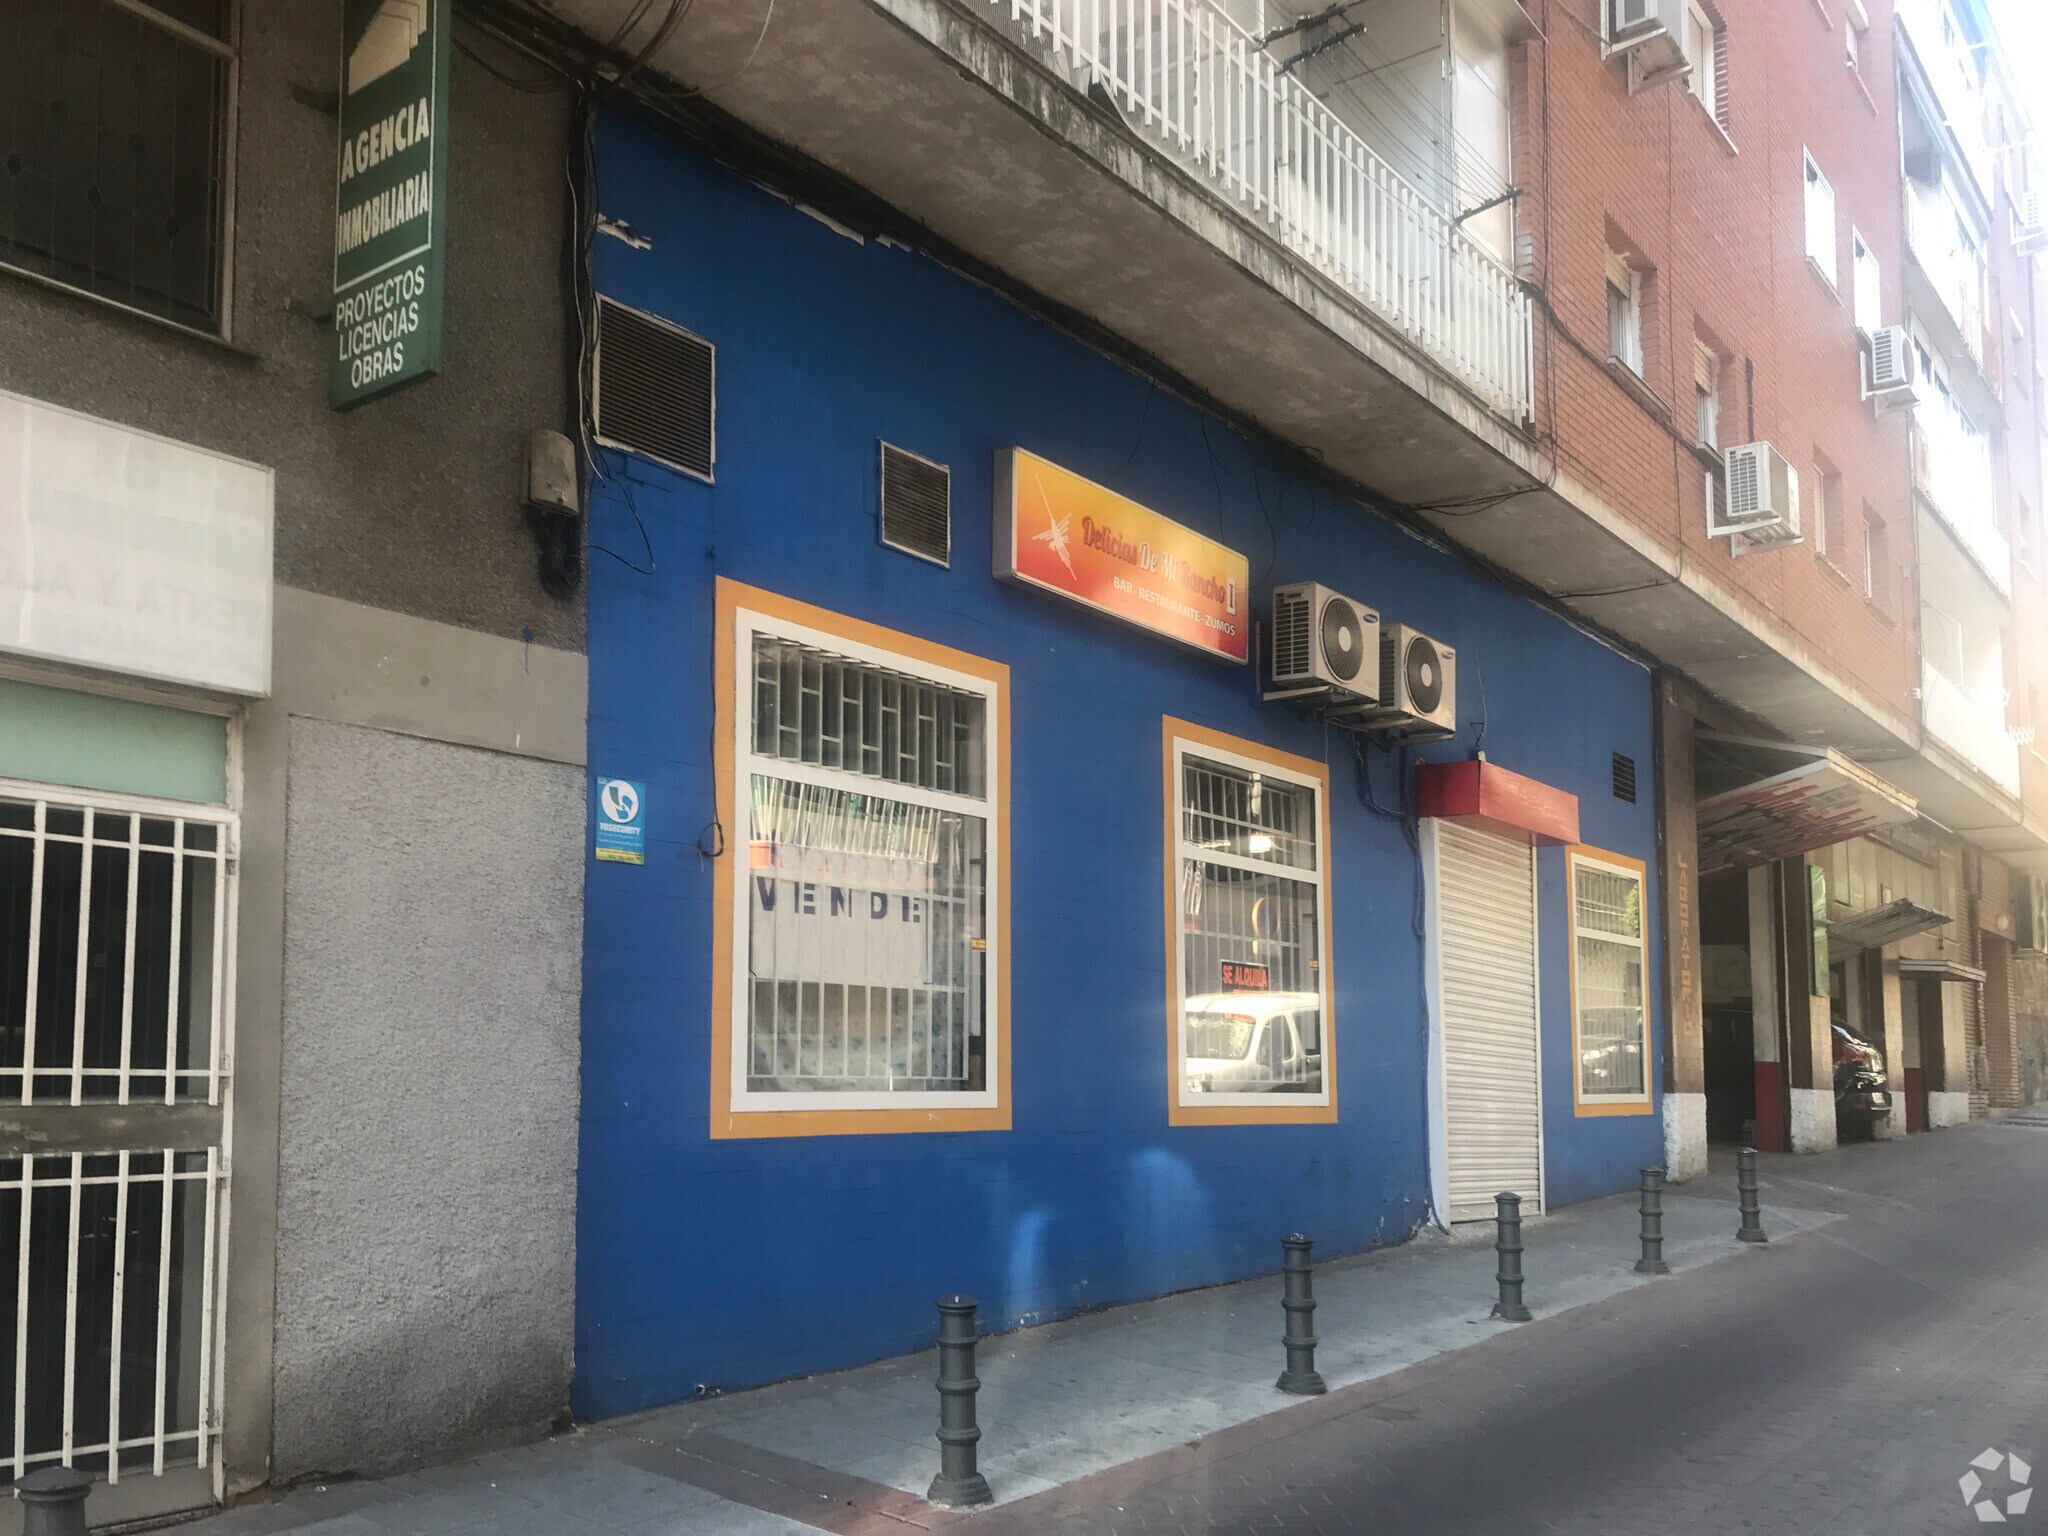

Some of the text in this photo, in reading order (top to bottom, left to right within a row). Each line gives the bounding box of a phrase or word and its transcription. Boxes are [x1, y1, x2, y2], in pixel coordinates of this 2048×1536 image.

[341, 97, 429, 183] AGENCIA
[338, 171, 428, 256] INMOBILIARIA
[336, 264, 425, 331] PROYECTOS
[340, 301, 419, 362] LICENCIAS
[351, 341, 404, 389] OBRAS
[1082, 515, 1138, 566] Delicias
[1140, 541, 1159, 575] De
[1161, 551, 1178, 582] Mi
[1180, 560, 1227, 604] Rancho
[1113, 576, 1133, 594] BAR
[1139, 587, 1200, 623] RESTAURANTE
[1205, 614, 1236, 636] ZUMOS
[756, 875, 921, 924] VENDE
[1222, 964, 1268, 988] SE ALQUILA
